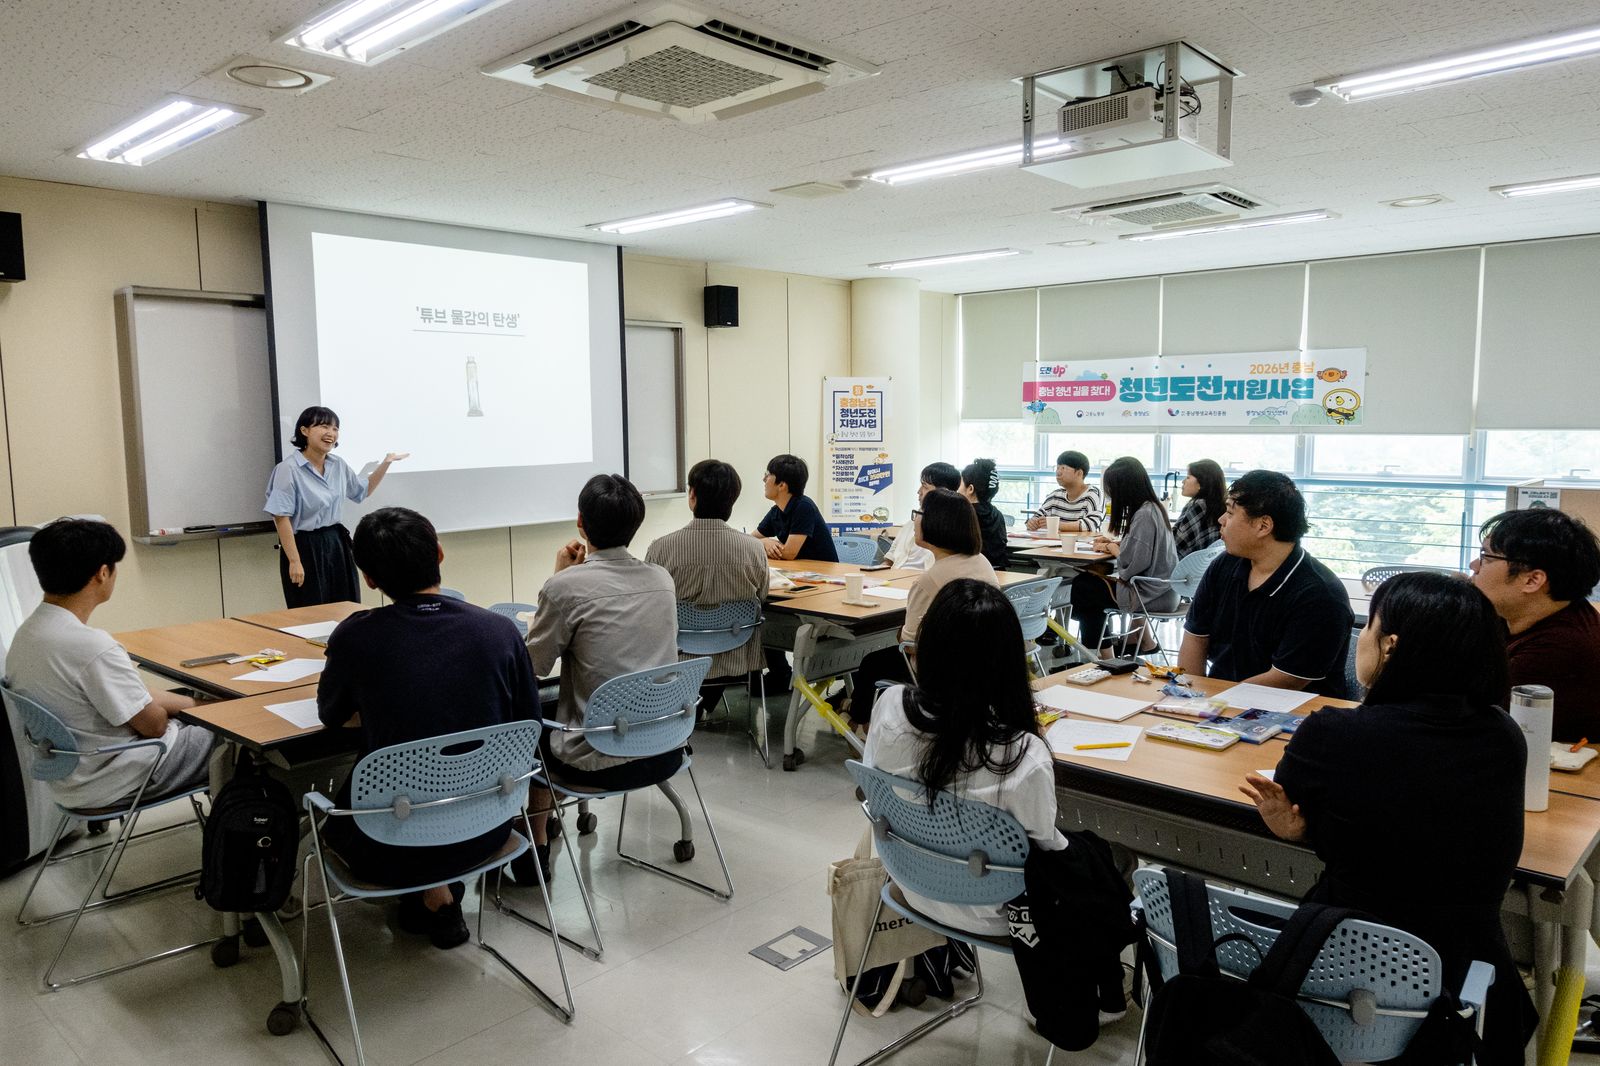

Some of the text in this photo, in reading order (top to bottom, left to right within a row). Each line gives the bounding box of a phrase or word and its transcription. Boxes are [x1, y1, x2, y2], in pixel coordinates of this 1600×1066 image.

[416, 306, 521, 329] '튜브 물감의 탄생'
[1249, 361, 1314, 375] 2026년 충남
[1038, 385, 1111, 397] 충남 청년 길을 찾다!
[1119, 376, 1314, 402] 청년도전지원사업
[839, 408, 877, 418] 청년도전
[839, 419, 877, 429] 지원사업
